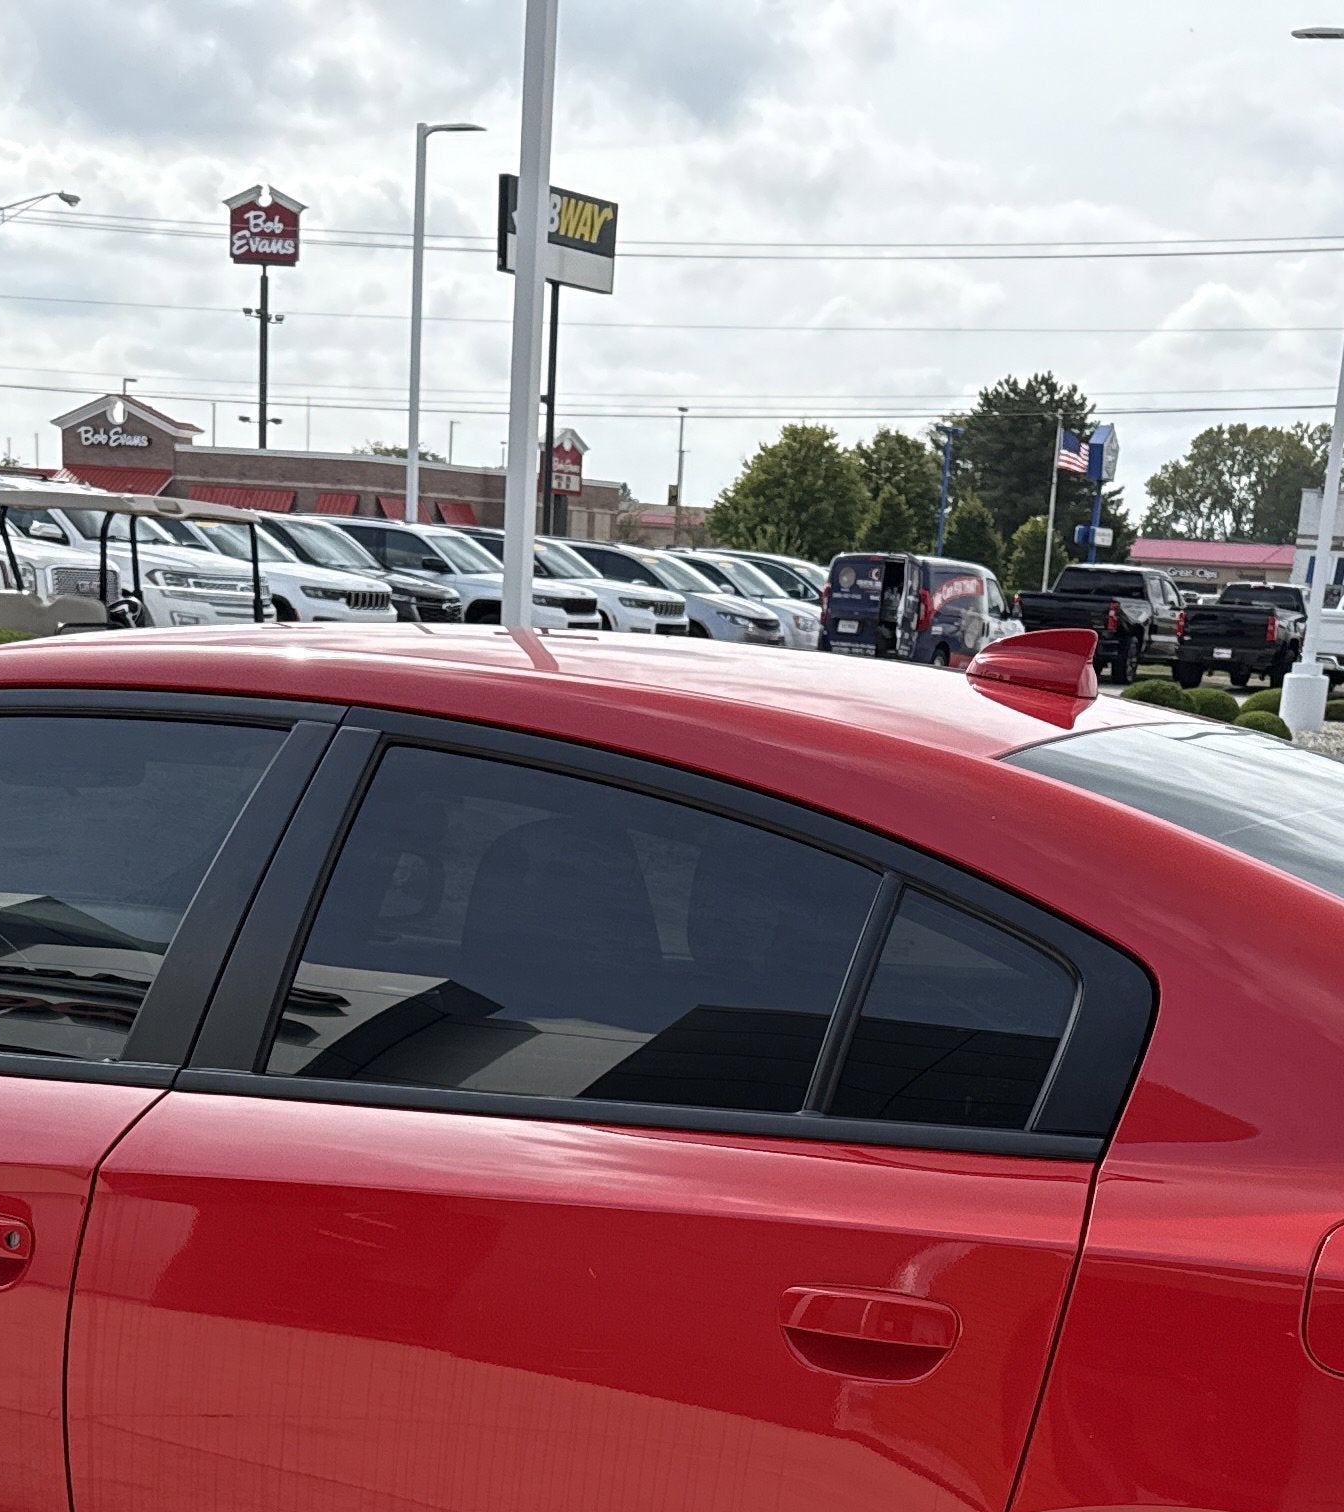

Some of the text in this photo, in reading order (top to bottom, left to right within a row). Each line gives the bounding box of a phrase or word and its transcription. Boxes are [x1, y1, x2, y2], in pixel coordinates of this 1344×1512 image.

[244, 210, 284, 233] Bob
[512, 193, 614, 243] BWAY
[232, 230, 295, 255] Evans
[77, 426, 149, 447] Bob Evans
